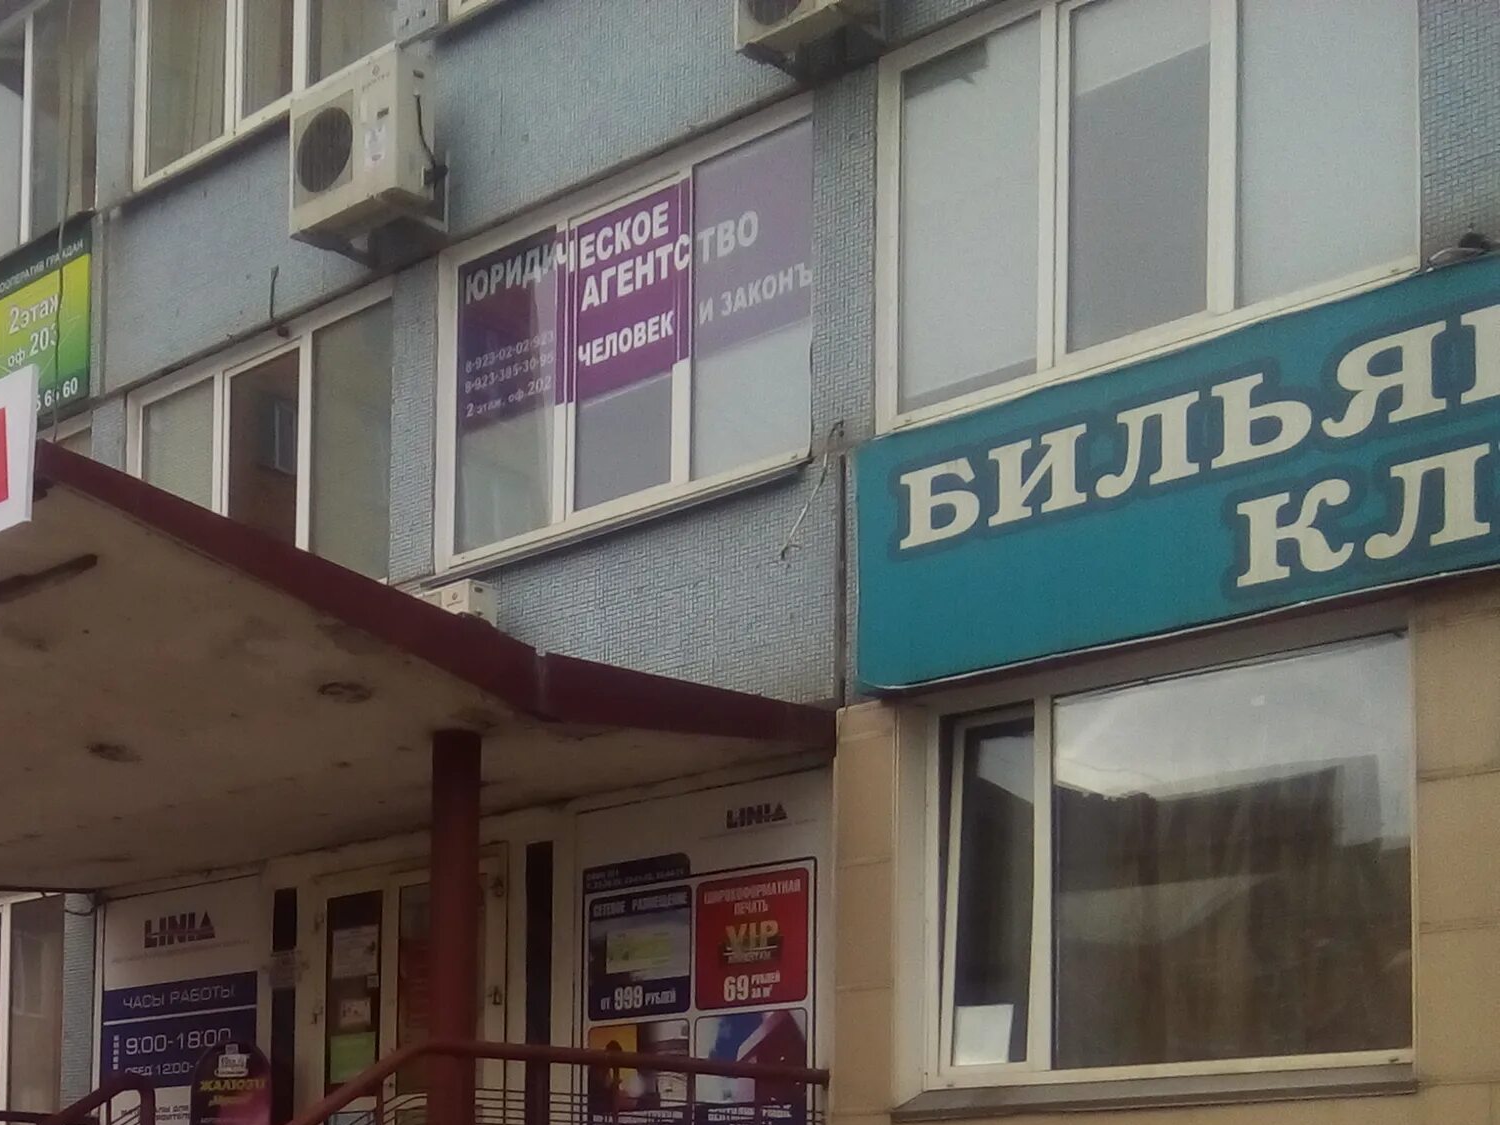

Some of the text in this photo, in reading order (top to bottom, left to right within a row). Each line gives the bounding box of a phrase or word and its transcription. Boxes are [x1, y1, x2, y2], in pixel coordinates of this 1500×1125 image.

[464, 201, 671, 305] ЮРИДИЧЕСКОЕ
[581, 209, 760, 312] АГЕНТСТВО
[577, 261, 814, 367] ЧЕЛОВЕК И ЗАКОНЪ
[62, 376, 78, 399] 60
[465, 401, 475, 418] 2
[1236, 440, 1500, 588] КЛ
[144, 911, 216, 949] LINIA
[724, 918, 780, 949] VIP
[123, 984, 236, 1009] ЧАСЫ РАБОТЫ
[723, 975, 749, 1002] 69
